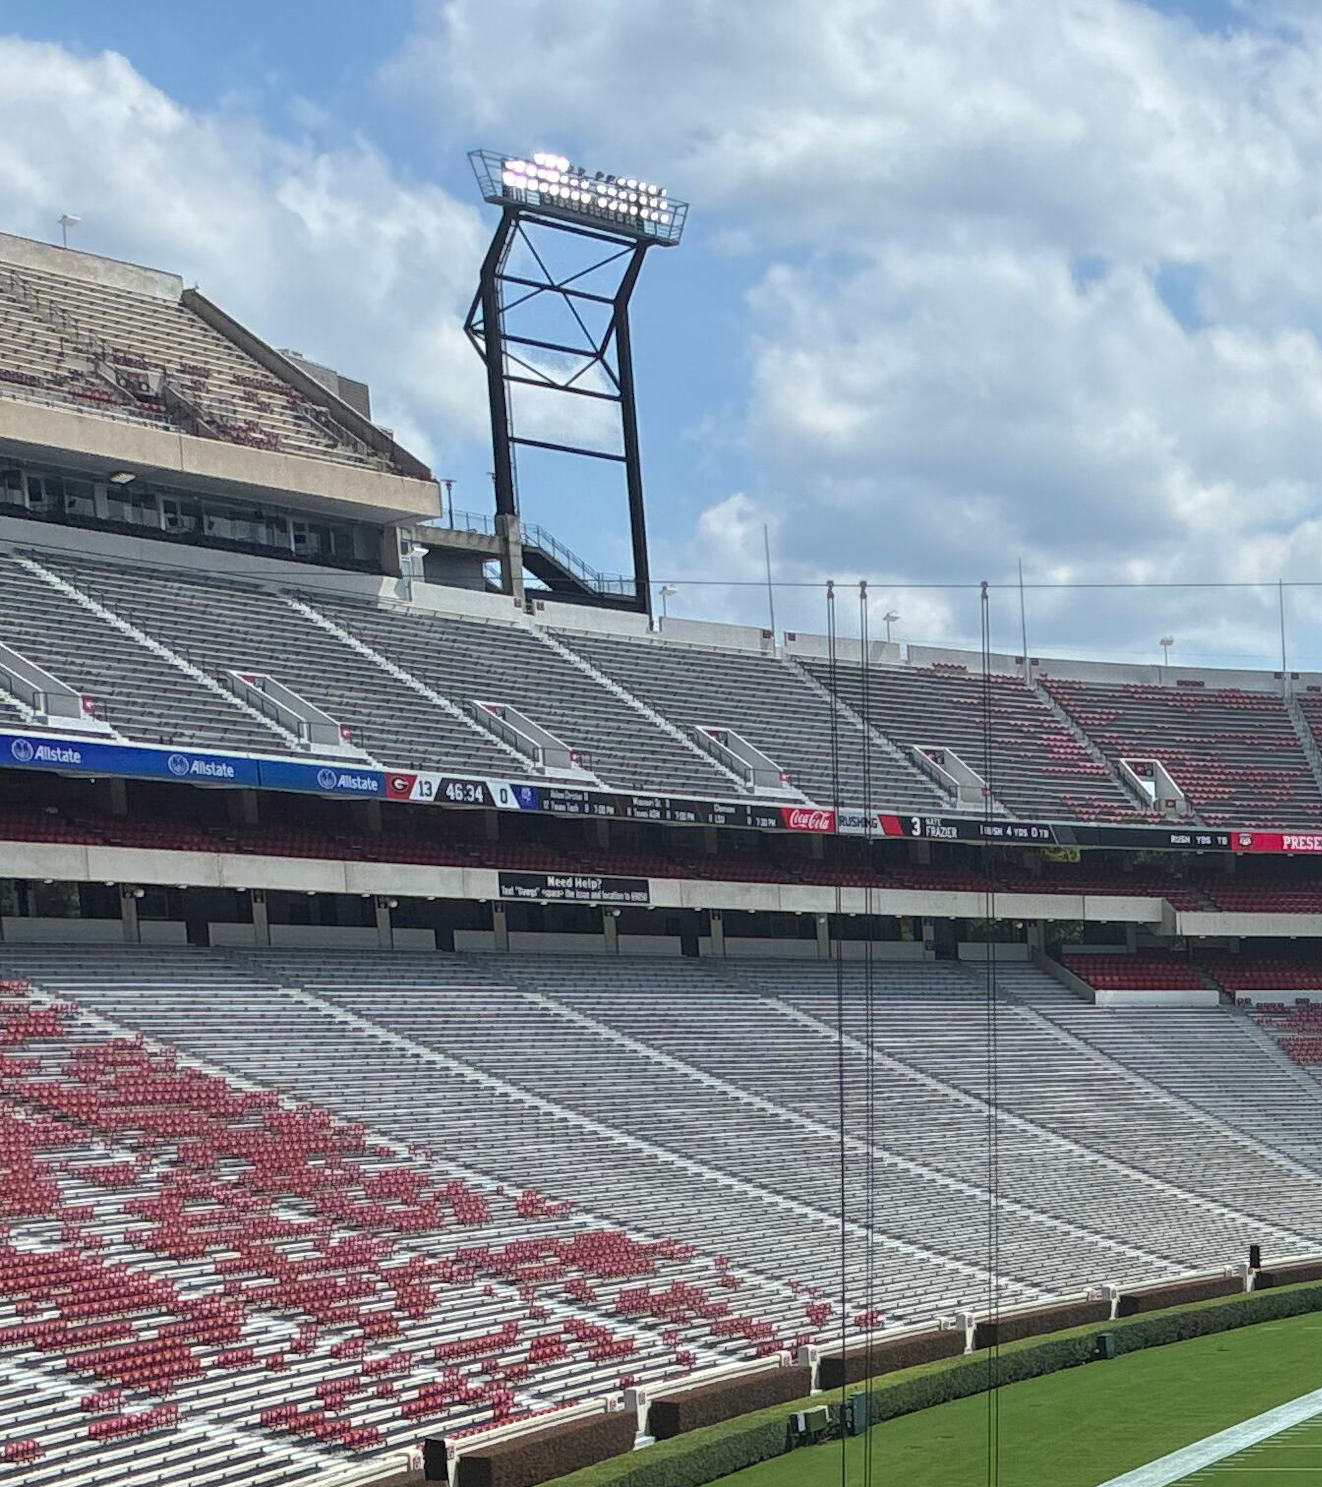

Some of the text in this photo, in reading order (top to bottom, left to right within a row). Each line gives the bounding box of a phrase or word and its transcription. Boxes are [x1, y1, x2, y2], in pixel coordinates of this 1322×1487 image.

[34, 745, 81, 764] Allstate
[190, 759, 235, 778] Allstate
[337, 774, 379, 791] Allstate
[418, 780, 433, 798] 13
[911, 817, 921, 836] 3
[547, 876, 602, 890] Need Help?
